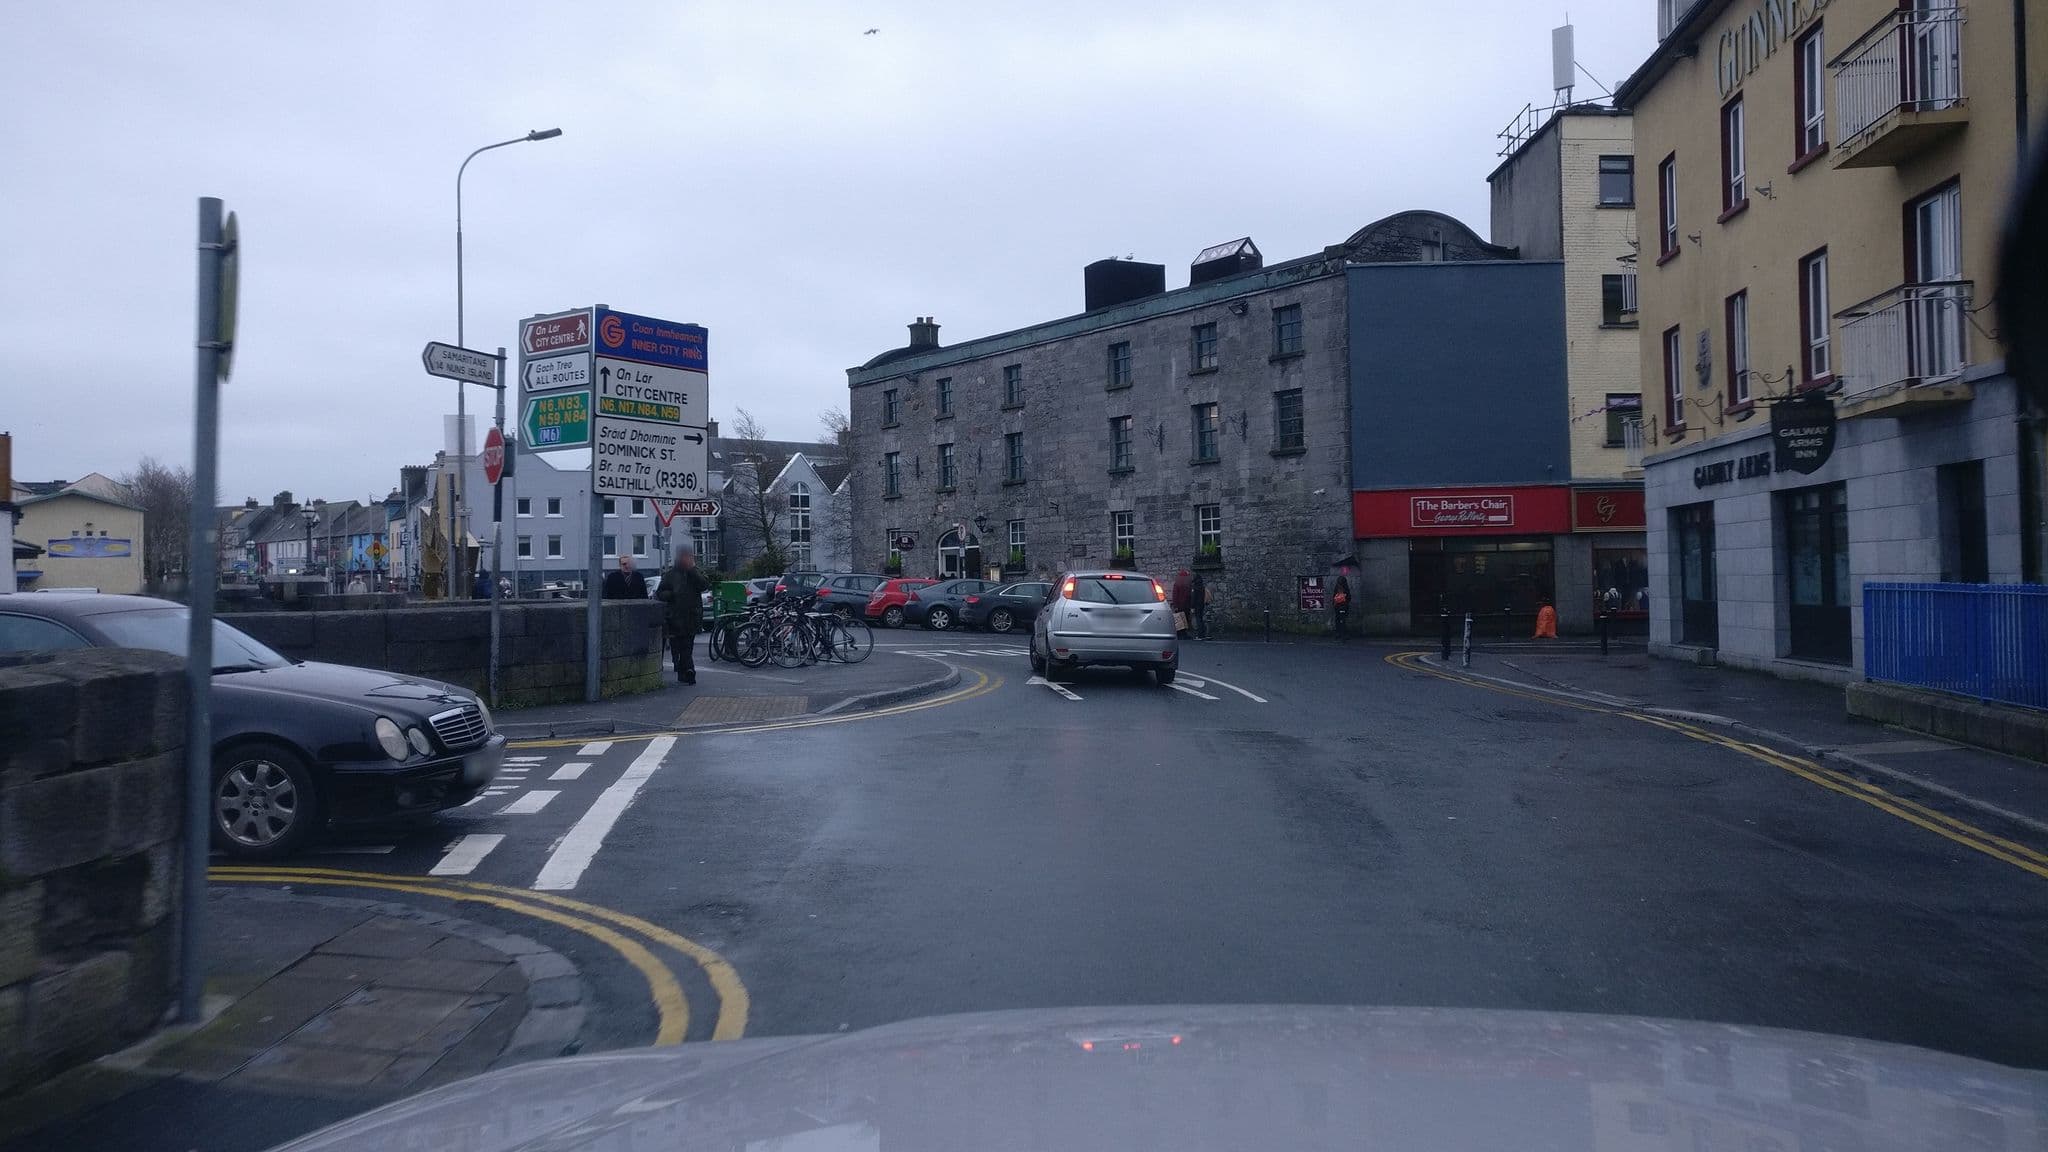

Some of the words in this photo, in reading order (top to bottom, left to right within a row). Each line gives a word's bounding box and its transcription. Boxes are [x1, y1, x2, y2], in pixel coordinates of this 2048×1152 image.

[1713, 0, 1833, 100] GUINNE
[536, 337, 549, 348] CITY
[550, 333, 575, 345] CENTRE
[632, 339, 657, 353] INNER
[660, 344, 680, 357] CITY
[683, 347, 703, 360] RING
[442, 350, 488, 367] SAMARITANS
[446, 363, 465, 375] NUNS
[468, 368, 492, 380] ISLAND
[536, 362, 554, 373] Gach
[557, 361, 573, 371] Treo
[536, 375, 550, 386] ALL
[553, 370, 585, 383] ROUTES
[616, 384, 642, 399] CITY
[644, 388, 688, 405] CENTRE
[661, 406, 679, 419] N59
[540, 427, 559, 442] (M6)
[1779, 426, 1829, 437] GALWAY
[1788, 438, 1824, 448] ARMS
[485, 446, 503, 467] STOP
[599, 443, 656, 459] DOMINICK
[660, 449, 676, 461] ST.
[1795, 450, 1818, 458] INN
[599, 459, 613, 472] Br.
[618, 463, 631, 473] na
[598, 475, 650, 491] SALTHILL
[656, 469, 697, 491] (R336)
[1420, 500, 1439, 510] The
[1481, 499, 1507, 509] Chair
